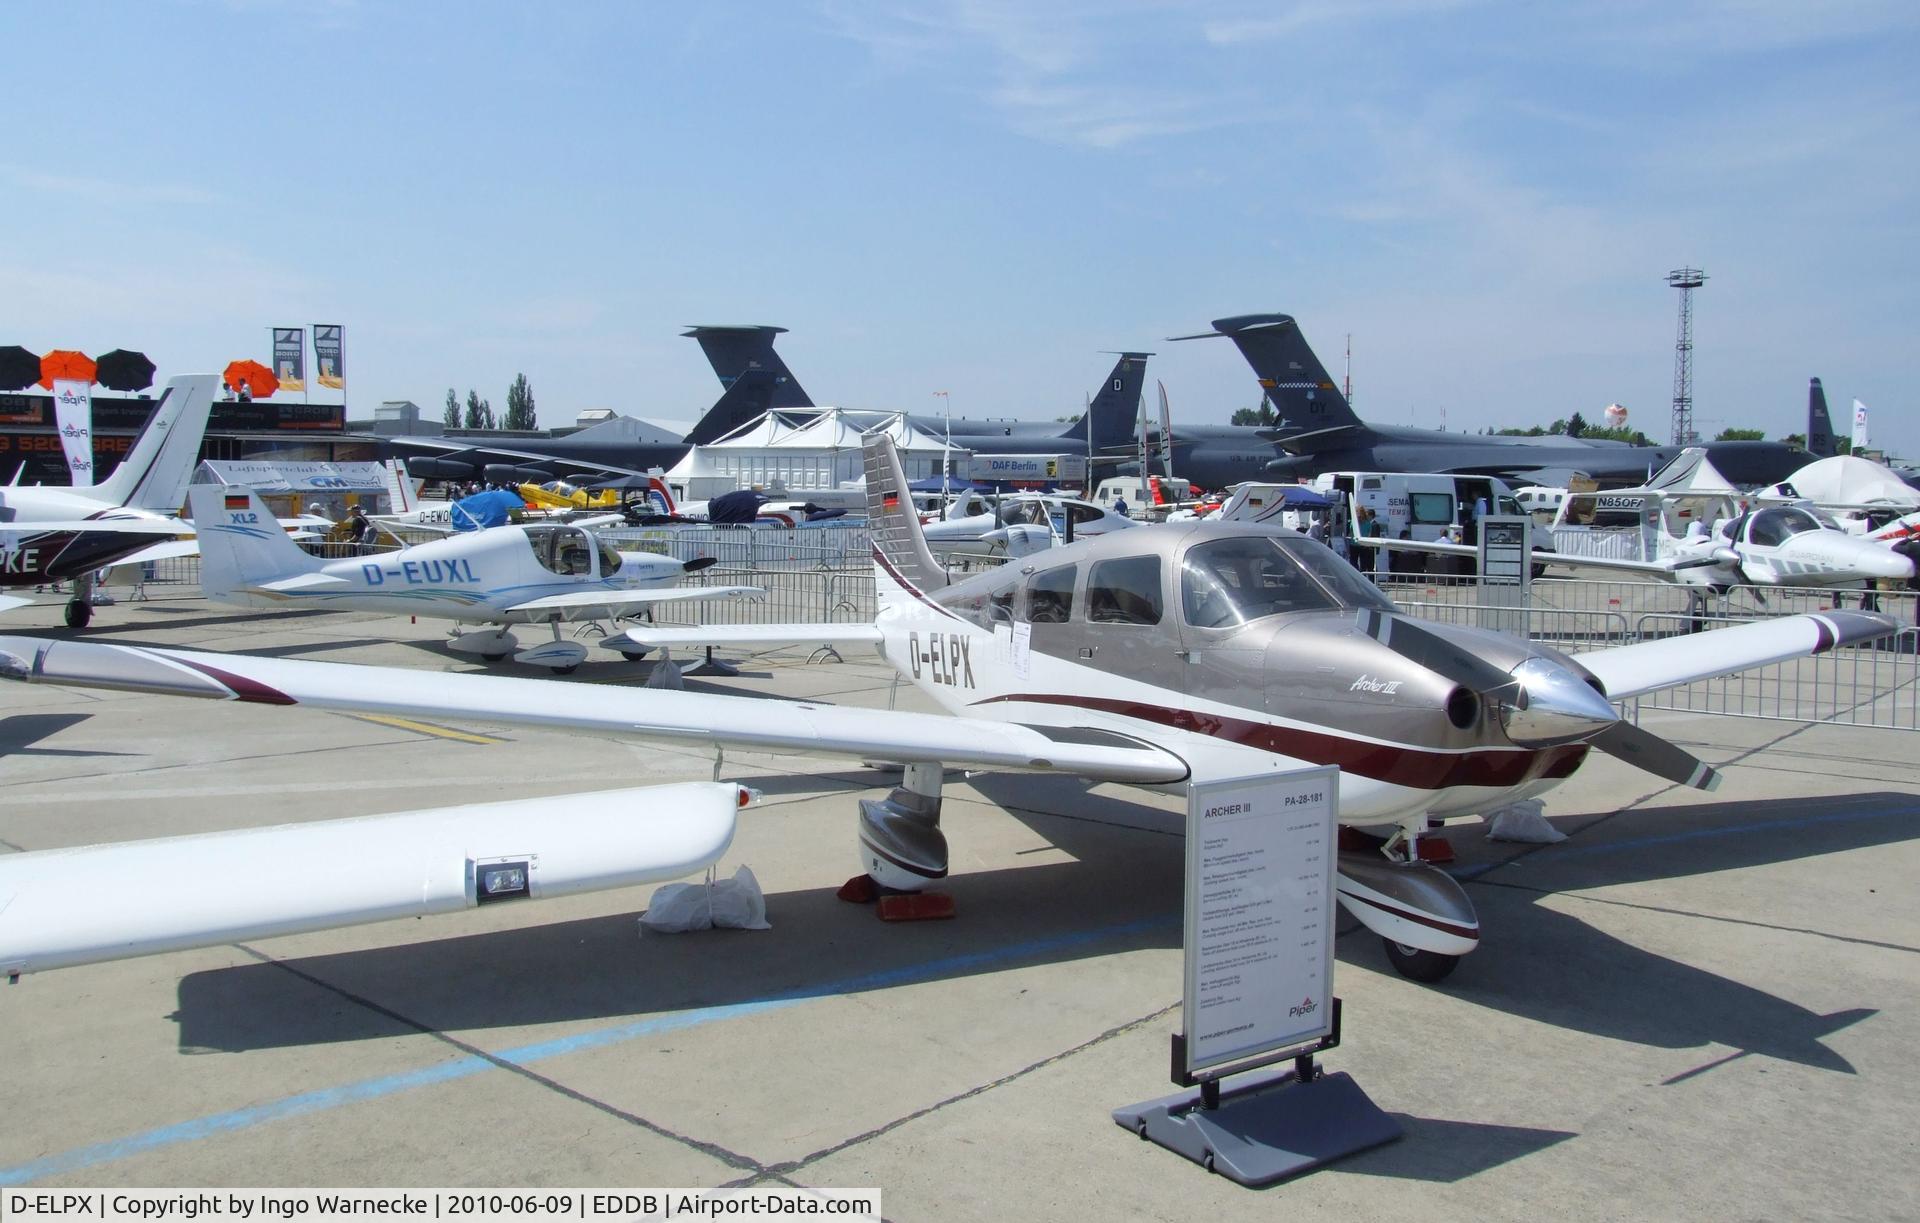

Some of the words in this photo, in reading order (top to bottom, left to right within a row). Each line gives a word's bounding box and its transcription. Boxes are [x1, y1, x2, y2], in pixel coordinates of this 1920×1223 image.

[1113, 379, 1122, 391] D
[1310, 401, 1328, 414] DY
[992, 461, 1010, 470] DAF
[1011, 461, 1037, 470] Berlin
[310, 477, 348, 488] CM
[231, 513, 259, 524] XL2
[1789, 550, 1834, 562] GUARDIAN
[362, 559, 481, 585] D-EUXL
[909, 631, 975, 690] D-ELPX
[1350, 674, 1386, 692] Archer
[1381, 681, 1403, 694] III
[1284, 792, 1323, 806] PA-28-181
[1204, 804, 1241, 818] ARCHER
[1243, 803, 1251, 813] III
[1289, 1002, 1318, 1017] Piper
